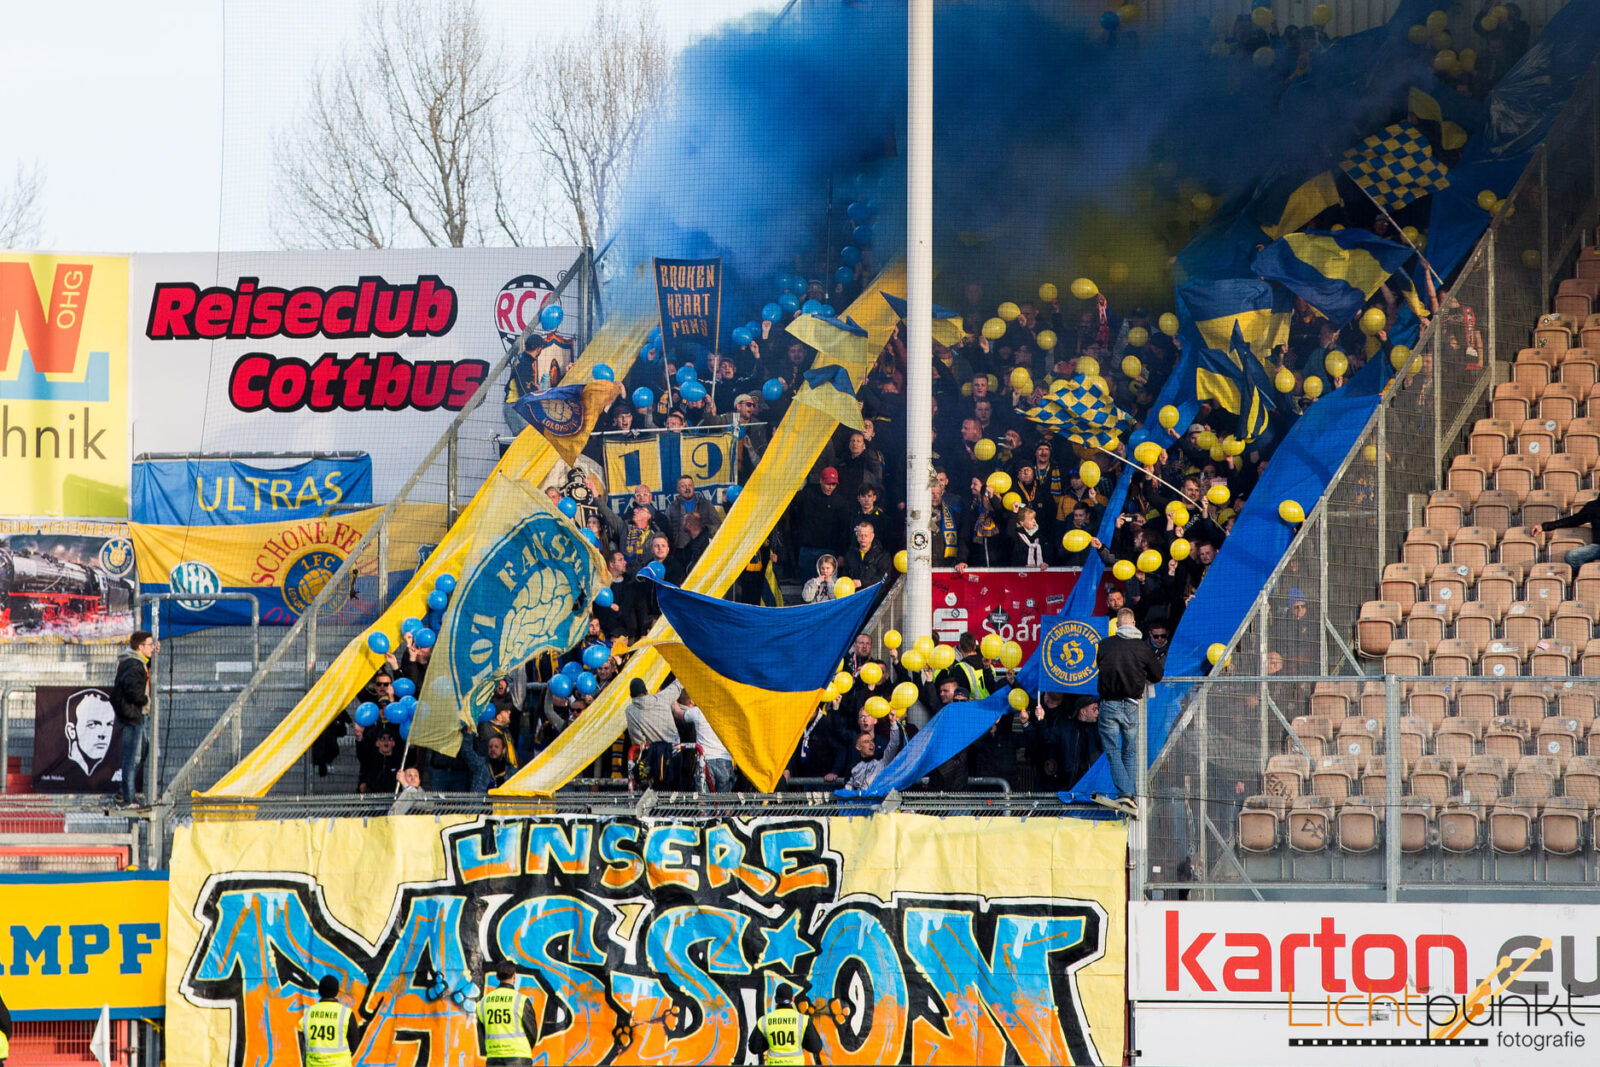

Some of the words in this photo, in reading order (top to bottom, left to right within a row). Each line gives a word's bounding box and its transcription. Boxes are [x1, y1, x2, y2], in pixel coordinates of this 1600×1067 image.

[660, 264, 715, 291] BROKEN
[56, 270, 84, 330] OHG
[147, 276, 456, 340] Reiseclub
[497, 290, 556, 332] RC
[667, 293, 710, 319] HEART
[229, 353, 489, 412] Cottbus
[196, 471, 343, 511] ULTRAS
[1050, 623, 1098, 645] LOKOMOTIVE
[1050, 664, 1093, 681] HOOLIGANS
[456, 822, 829, 897] UNSERE
[0, 922, 161, 976] MPF
[1165, 910, 1600, 995] karton.eu
[486, 995, 513, 1003] ORDNER
[310, 1010, 338, 1019] ORDNER
[486, 1008, 511, 1025] 265
[767, 1017, 797, 1025] ORDNER
[310, 1025, 335, 1041] 249
[769, 1030, 796, 1046] 104
